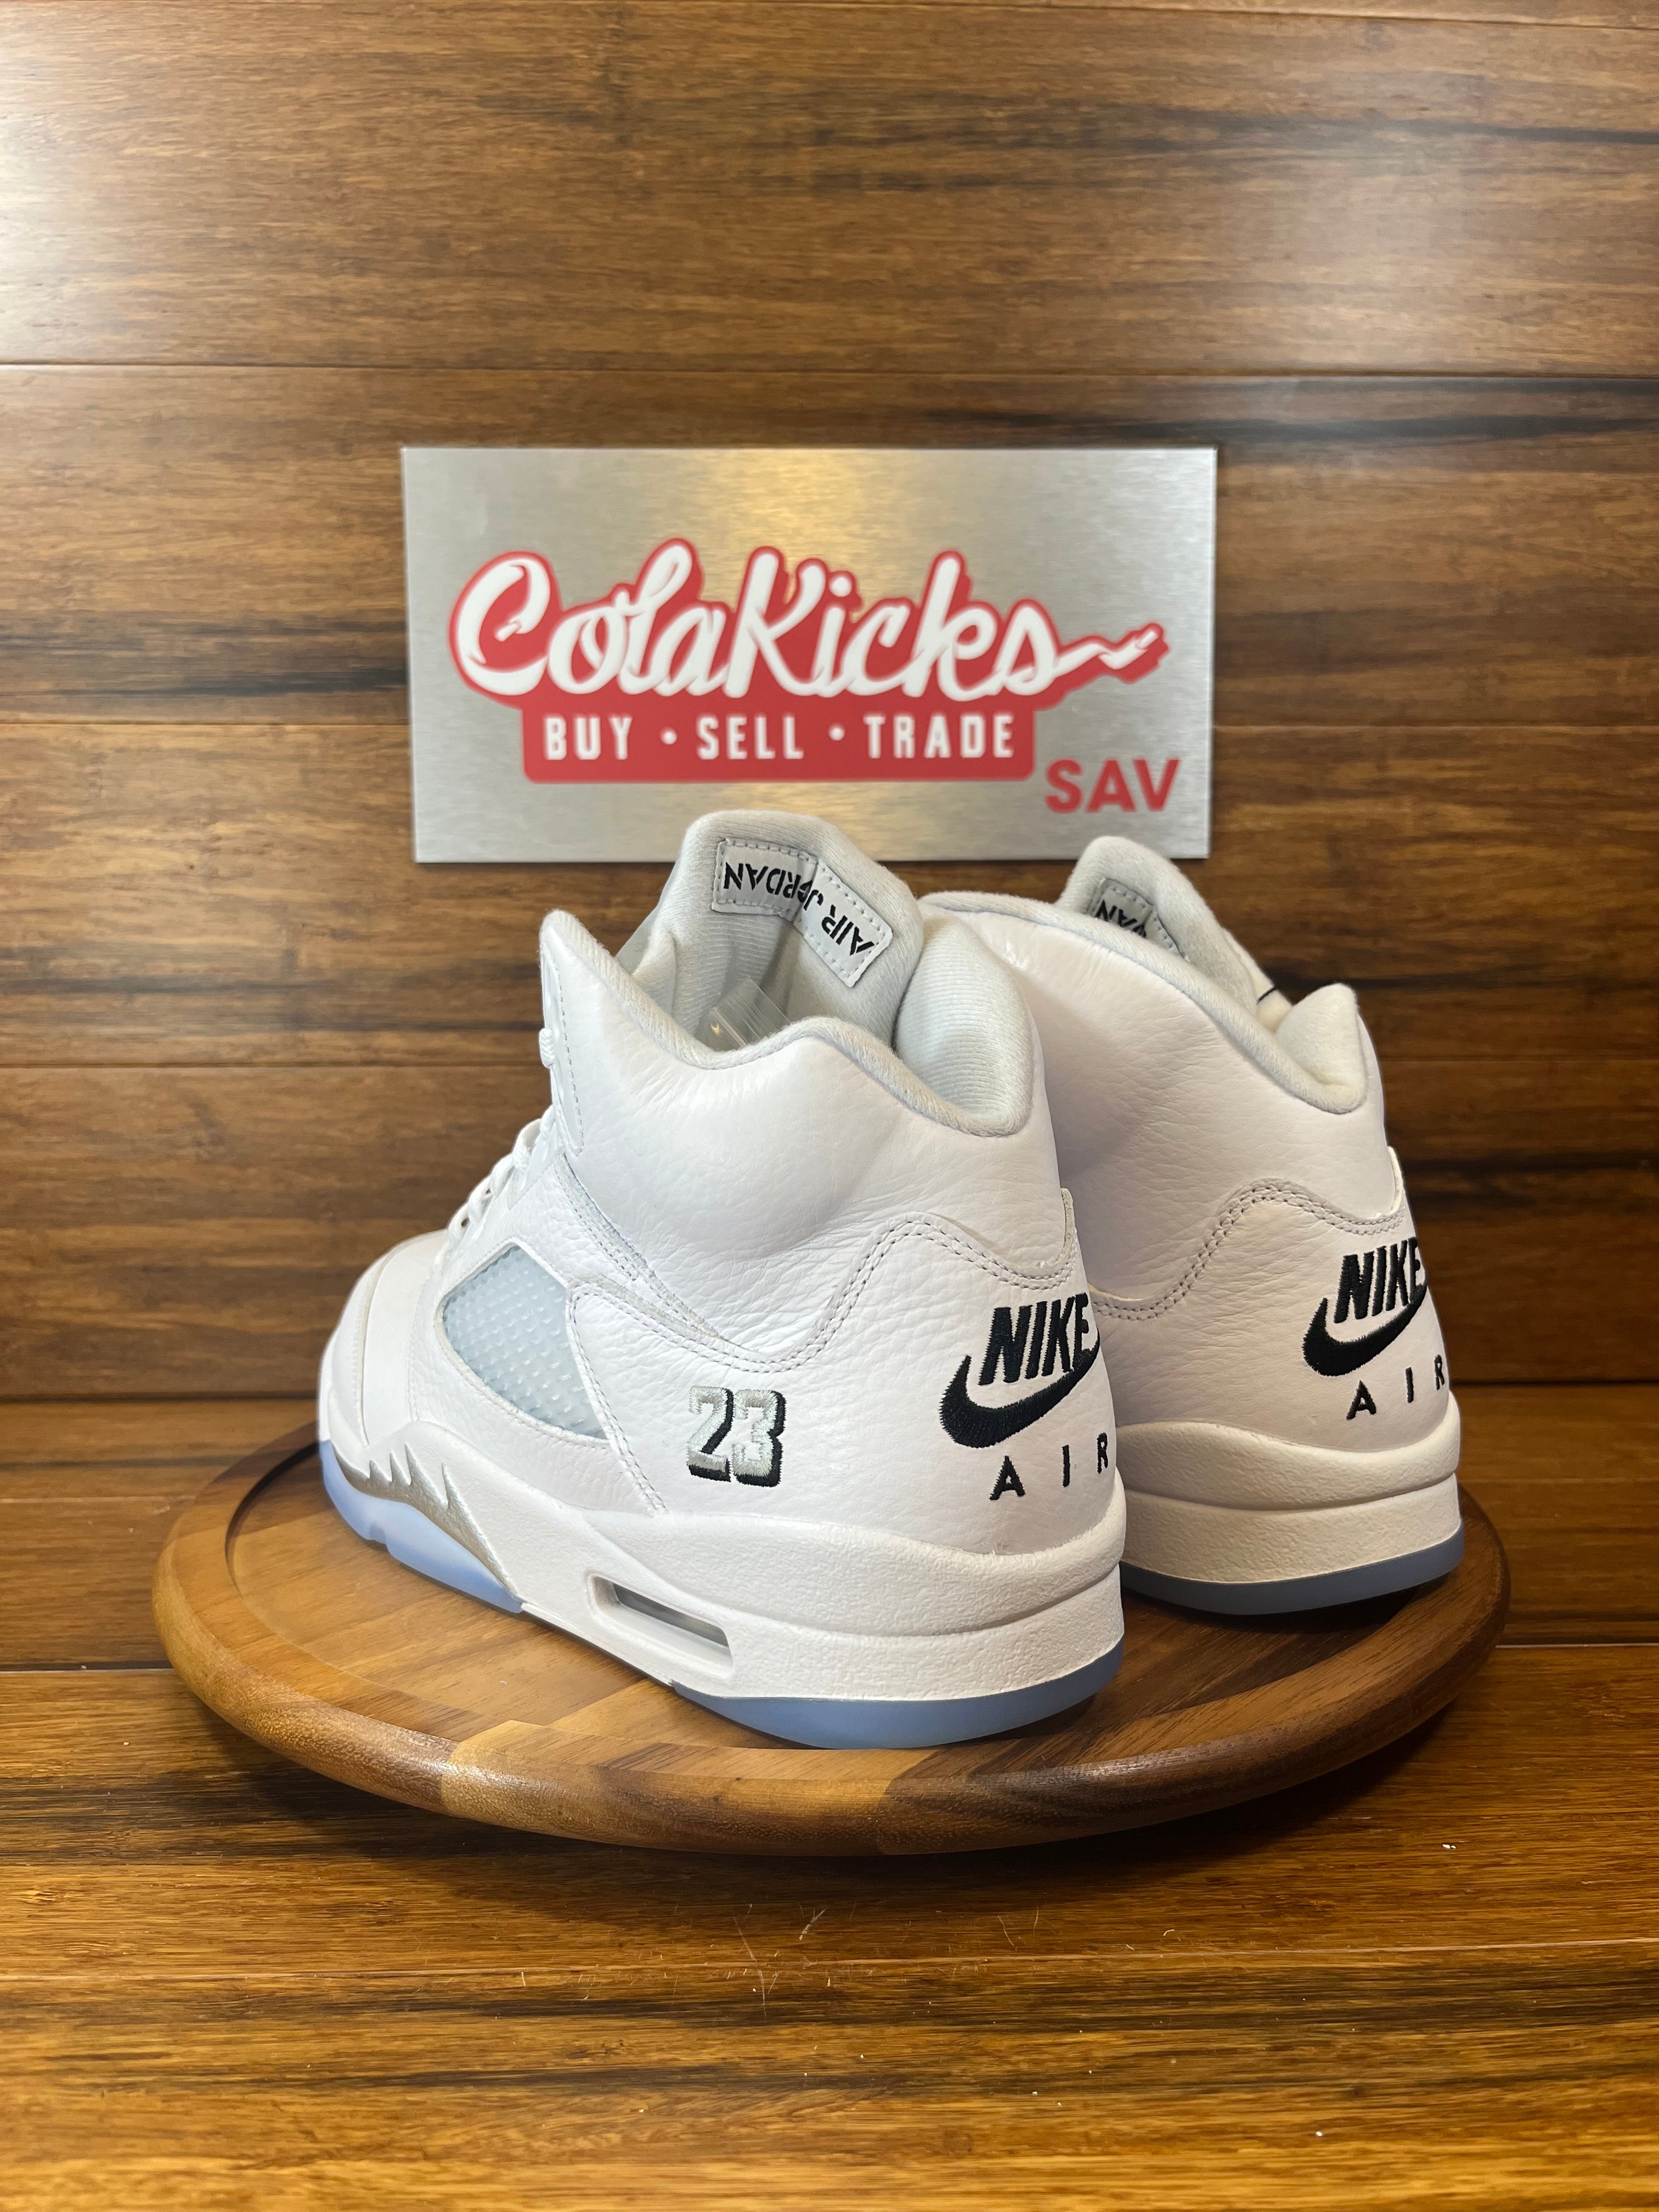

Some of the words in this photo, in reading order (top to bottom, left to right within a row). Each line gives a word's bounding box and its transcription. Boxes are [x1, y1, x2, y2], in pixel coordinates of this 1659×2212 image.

[456, 543, 1159, 702] ColaKicks
[543, 714, 633, 760] BUY
[696, 714, 804, 760] SELL
[862, 714, 1014, 760] TRADE
[1045, 758, 1181, 814] SAV
[821, 904, 875, 957] AIR
[1333, 1236, 1425, 1324] NIKE
[978, 1291, 1096, 1387] NIKE
[1346, 1353, 1446, 1420] AIR
[686, 1385, 788, 1488] 23
[989, 1432, 1109, 1502] AIR
